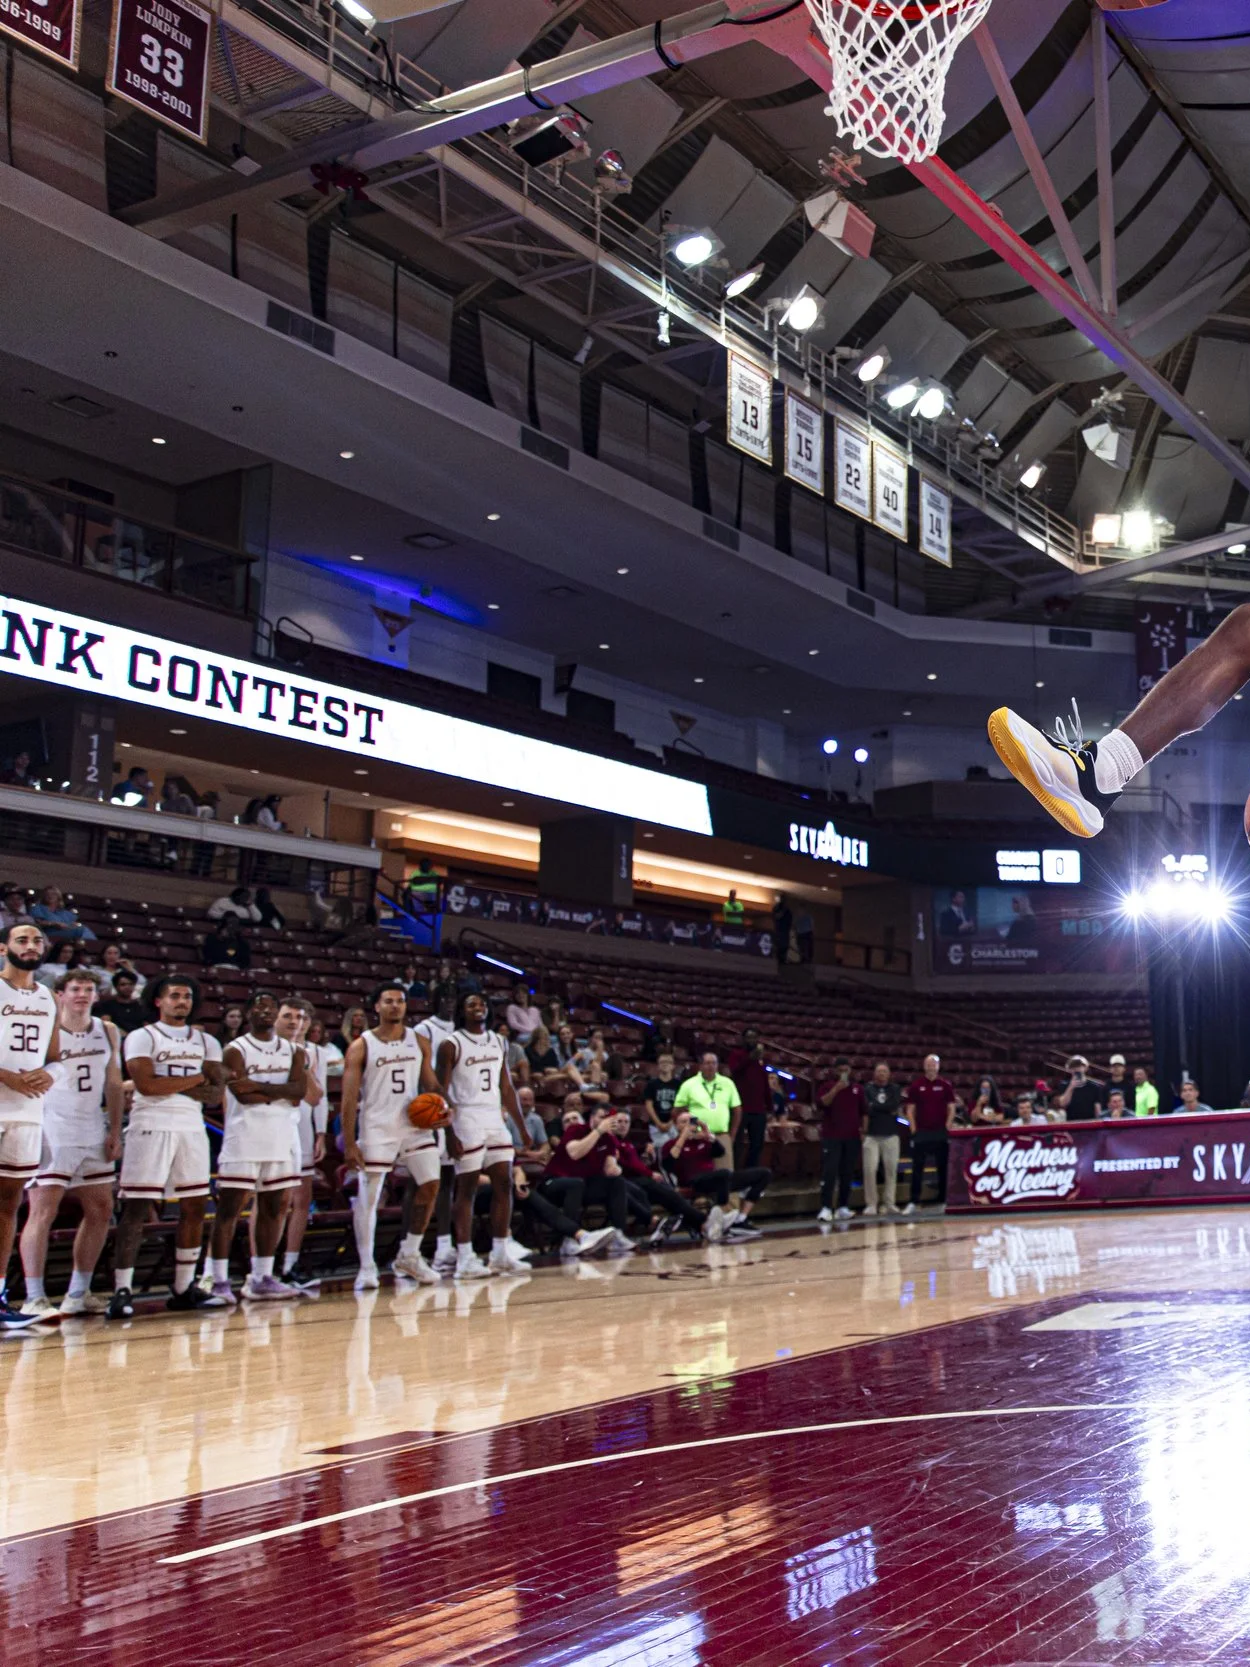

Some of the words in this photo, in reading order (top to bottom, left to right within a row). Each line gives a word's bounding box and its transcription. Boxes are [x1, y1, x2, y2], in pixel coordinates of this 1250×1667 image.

[136, 5, 192, 50] LUMPKIN
[151, 0, 182, 28] JODY
[140, 33, 184, 87] 33
[125, 69, 192, 119] 1998-2001
[742, 400, 758, 430] 13
[797, 433, 813, 462] 15
[846, 463, 860, 490] 22
[883, 485, 898, 511] 40
[930, 513, 942, 539] 14
[0, 610, 104, 681] NK
[127, 645, 384, 745] CONTEST
[87, 734, 99, 782] 112
[971, 949, 1038, 960] CHARLESTON
[10, 1023, 40, 1053] 32
[77, 1064, 92, 1092] 2
[391, 1069, 405, 1094] 5
[480, 1068, 491, 1092] 3
[970, 1140, 1078, 1175] Madness
[1094, 1158, 1161, 1172] PRESENTED
[1163, 1156, 1181, 1169] BY
[975, 1175, 1001, 1193] on
[991, 1167, 1076, 1198] Meeting
